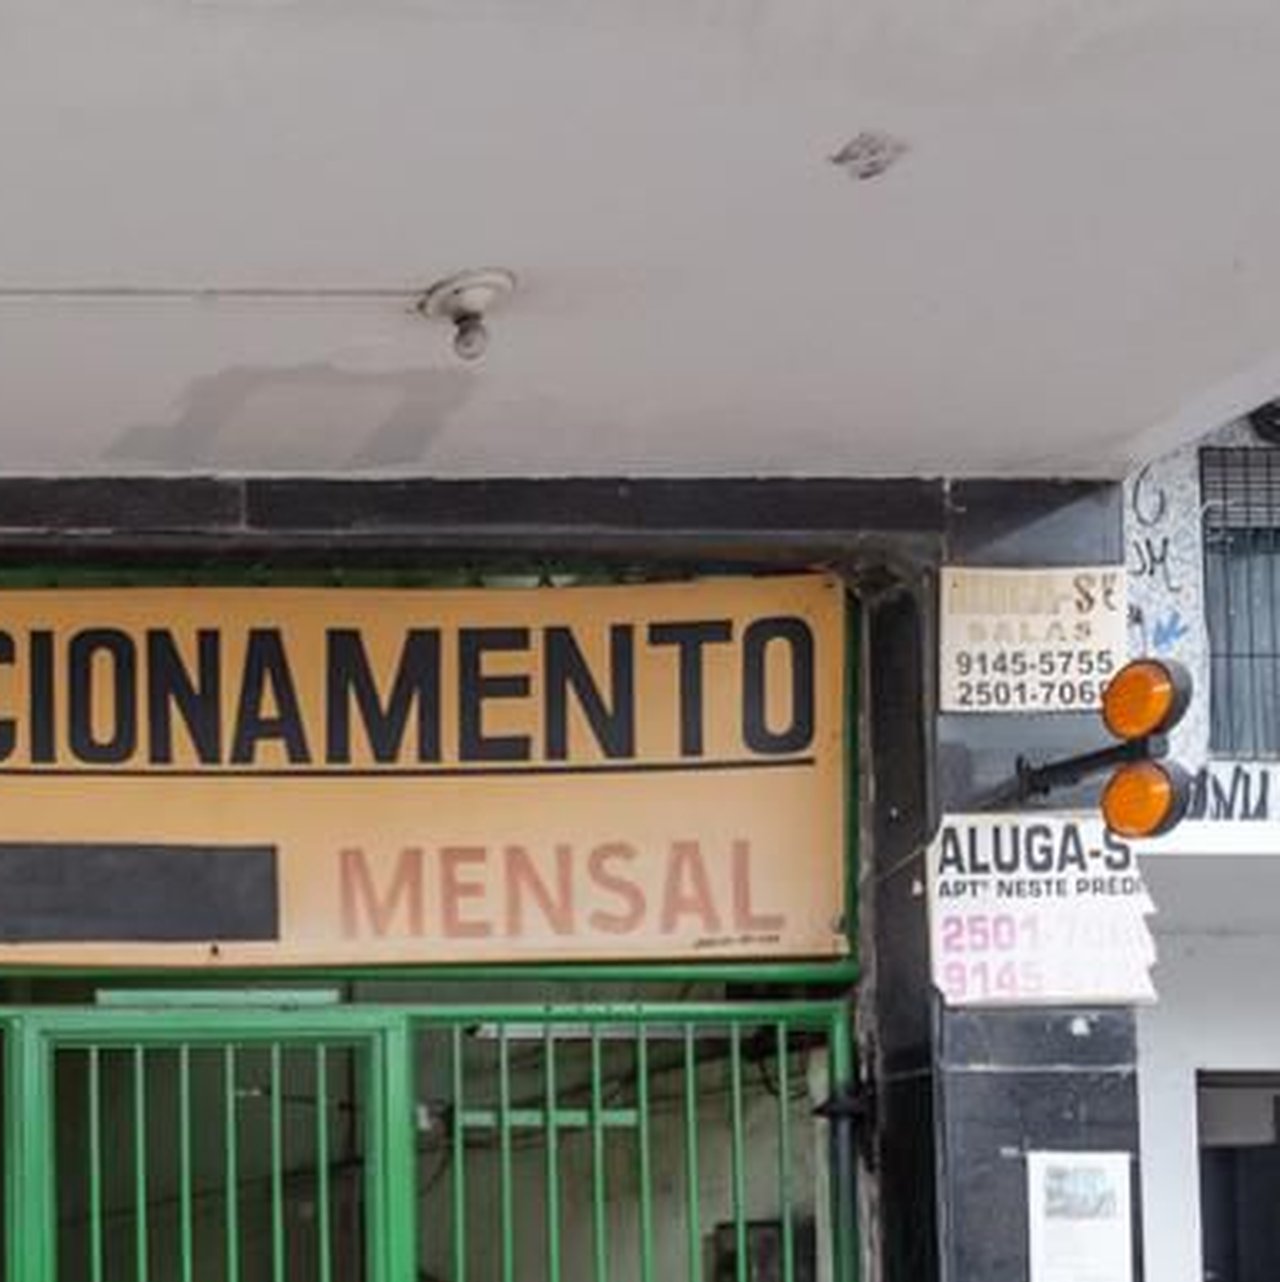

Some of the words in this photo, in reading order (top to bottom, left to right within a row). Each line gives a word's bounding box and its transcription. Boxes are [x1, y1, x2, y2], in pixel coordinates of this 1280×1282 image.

[955, 651, 1114, 675] 9145-5755
[339, 840, 786, 941] MENSAL
[996, 879, 1068, 898] NESTE
